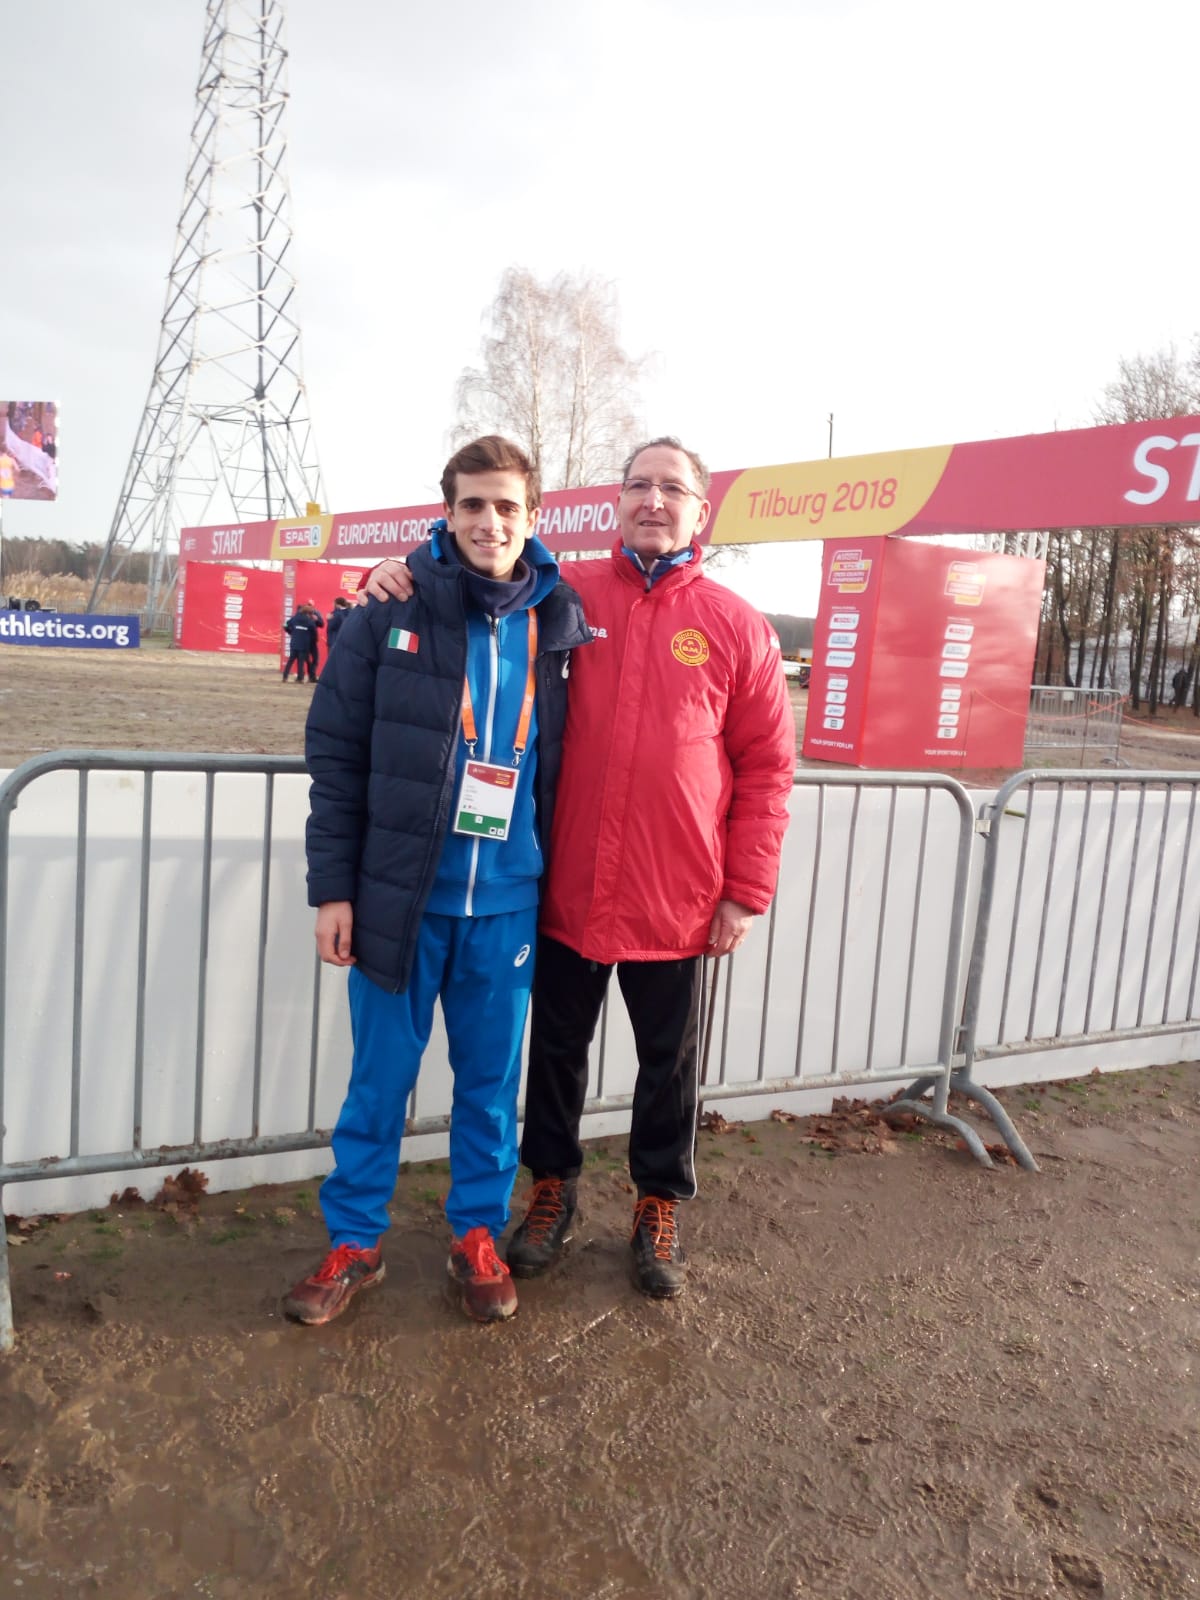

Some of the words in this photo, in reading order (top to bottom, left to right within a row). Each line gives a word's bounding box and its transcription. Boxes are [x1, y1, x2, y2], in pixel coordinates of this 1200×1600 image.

[748, 488, 828, 524] Tilburg
[832, 478, 898, 512] 2018
[285, 531, 310, 544] SPAR
[338, 520, 399, 546] EUROPEAN
[400, 517, 437, 543] CROS
[534, 502, 618, 536] HAMPIO
[211, 528, 245, 555] START
[0, 614, 129, 646] thletics.org
